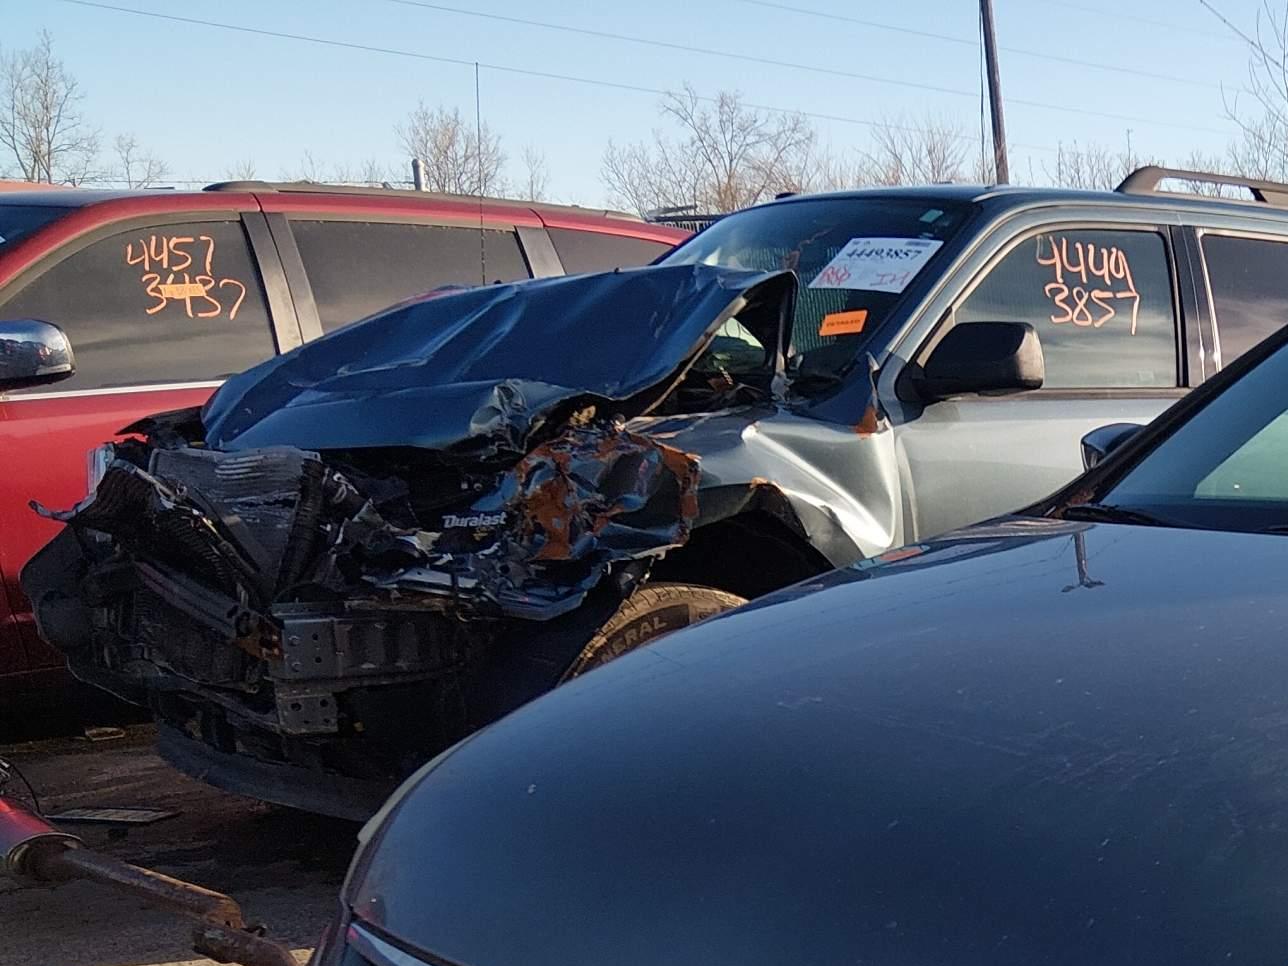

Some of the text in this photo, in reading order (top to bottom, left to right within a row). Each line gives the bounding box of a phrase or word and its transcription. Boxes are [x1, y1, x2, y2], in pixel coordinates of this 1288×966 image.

[126, 235, 214, 276] 4457
[1036, 234, 1135, 293] 4449
[1044, 282, 1140, 336] 3857
[441, 511, 508, 529] Duralast
